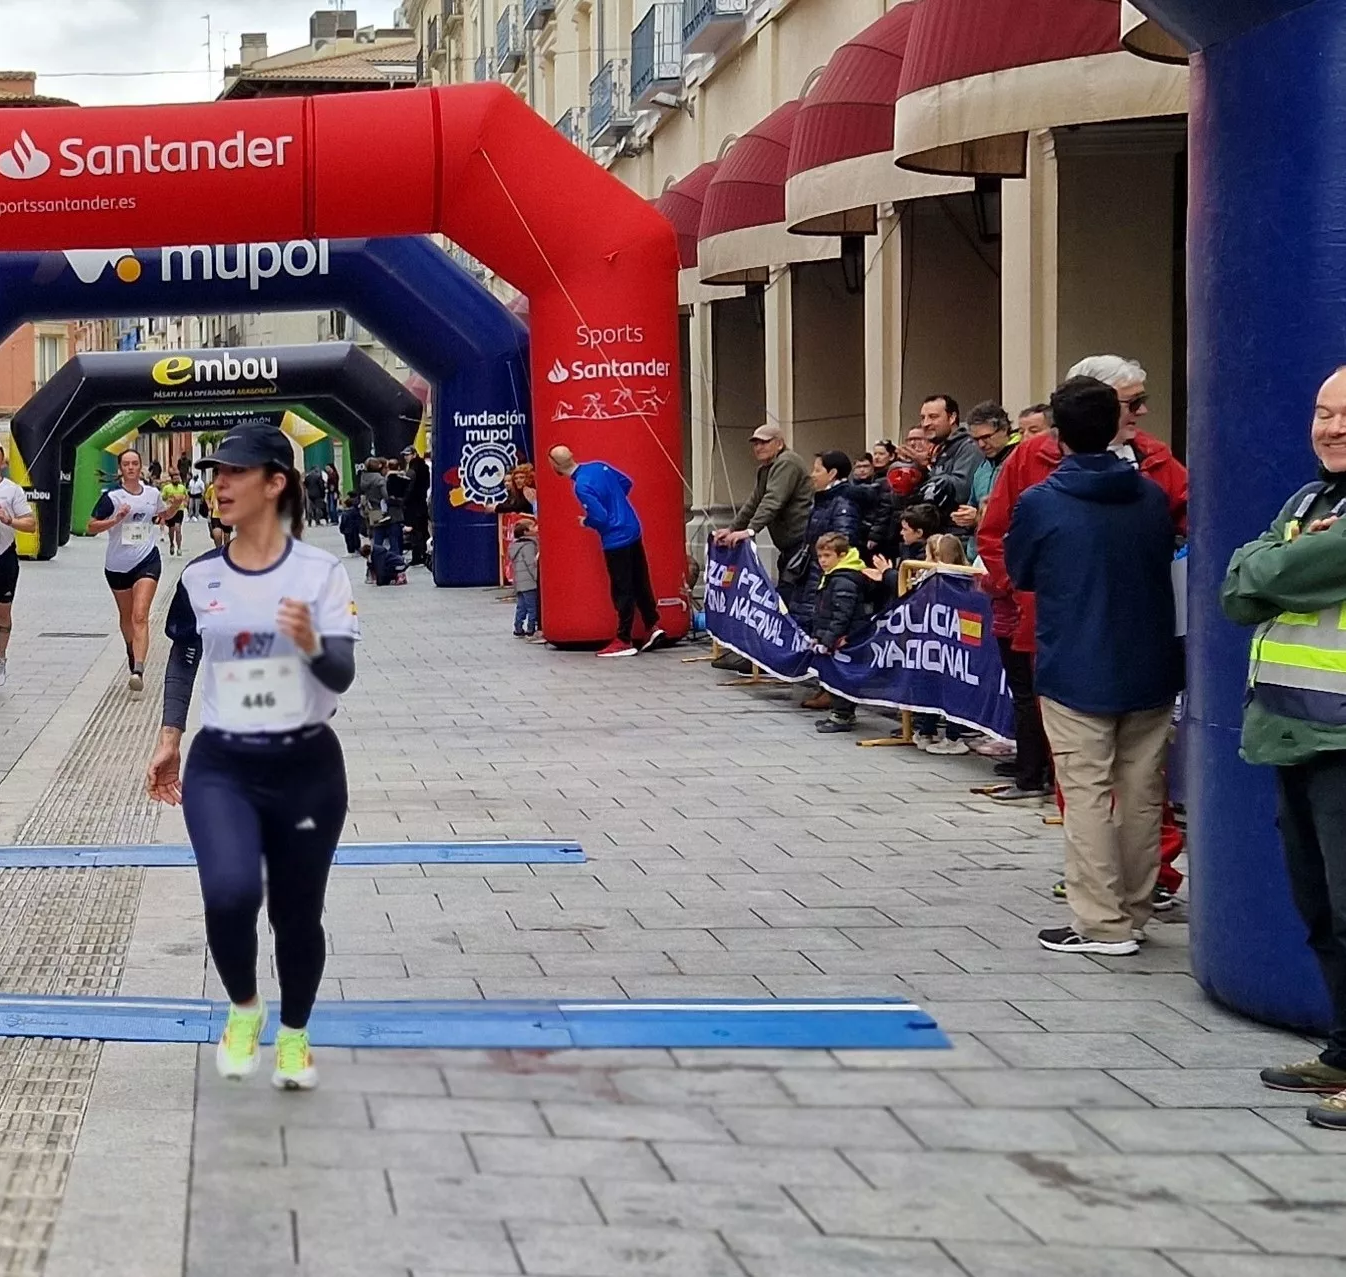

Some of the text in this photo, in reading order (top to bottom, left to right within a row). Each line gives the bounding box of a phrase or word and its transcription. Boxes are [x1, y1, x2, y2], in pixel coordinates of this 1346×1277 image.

[59, 130, 293, 177] Santander
[161, 238, 329, 290] mupol
[577, 324, 643, 348] Sports
[152, 352, 277, 385] embou
[572, 358, 670, 380] Santander
[453, 410, 526, 427] fundación
[466, 425, 513, 442] mupol
[24, 489, 51, 500] mbou
[870, 639, 979, 686] NACIONAL
[241, 691, 276, 709] 446
